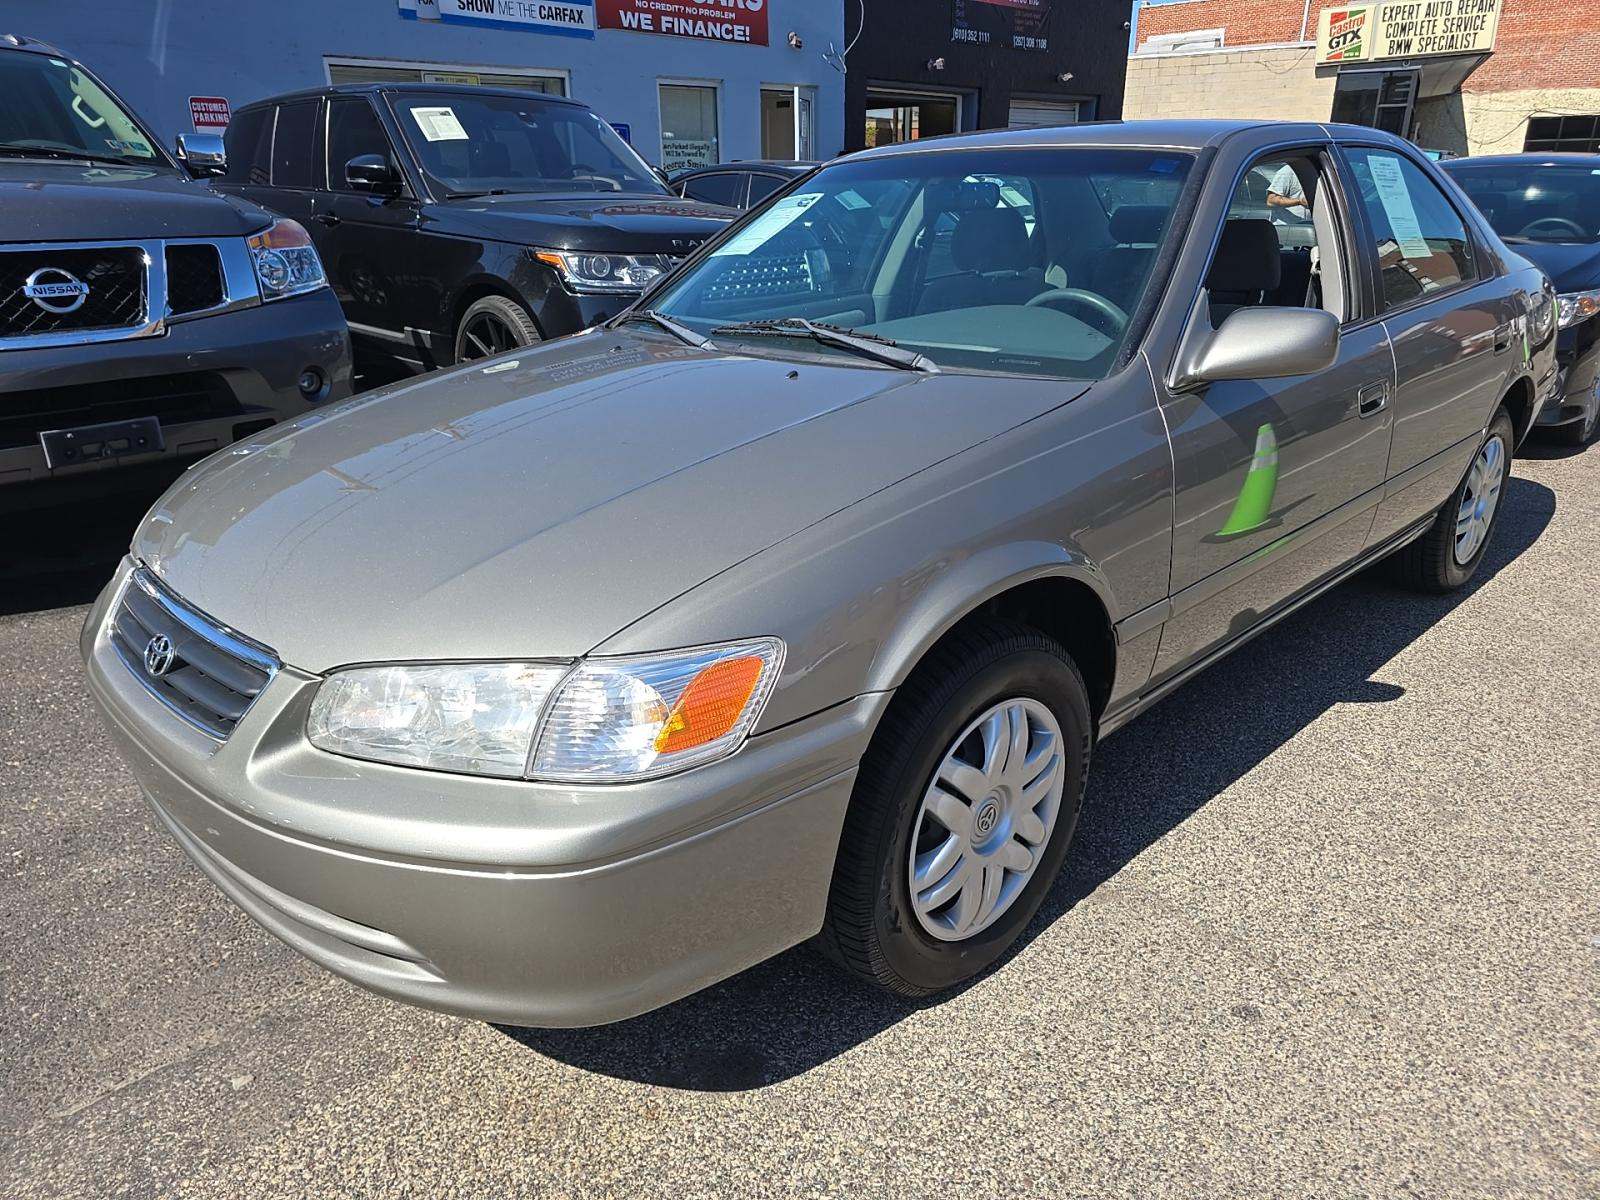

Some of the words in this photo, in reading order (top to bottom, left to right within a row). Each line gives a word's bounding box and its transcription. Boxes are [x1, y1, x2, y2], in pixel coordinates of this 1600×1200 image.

[457, 0, 495, 14] SHOW
[498, 1, 515, 16] ME
[517, 2, 537, 19] THE
[539, 5, 585, 24] CARFAX
[635, 0, 648, 8] NO
[650, 3, 684, 13] CREDIT?
[685, 7, 698, 15] NO
[699, 8, 736, 20] PROBLEM
[1382, 4, 1422, 22] EXPERT
[1424, 1, 1452, 18] AUTO
[1457, 0, 1495, 15] REPAIR
[619, 10, 654, 31] WE
[661, 15, 750, 42] FINANCE!
[1329, 14, 1366, 37] Castrol
[1385, 20, 1440, 39] COMPLETE
[1443, 15, 1487, 34] SERVICE
[1328, 28, 1362, 50] GTX
[1388, 38, 1413, 55] BMW
[1417, 32, 1479, 53] SPECIALIST
[192, 102, 228, 112] CUSTOMER
[193, 112, 230, 123] PARKING
[672, 239, 705, 247] RA
[32, 284, 83, 295] NISSAN
